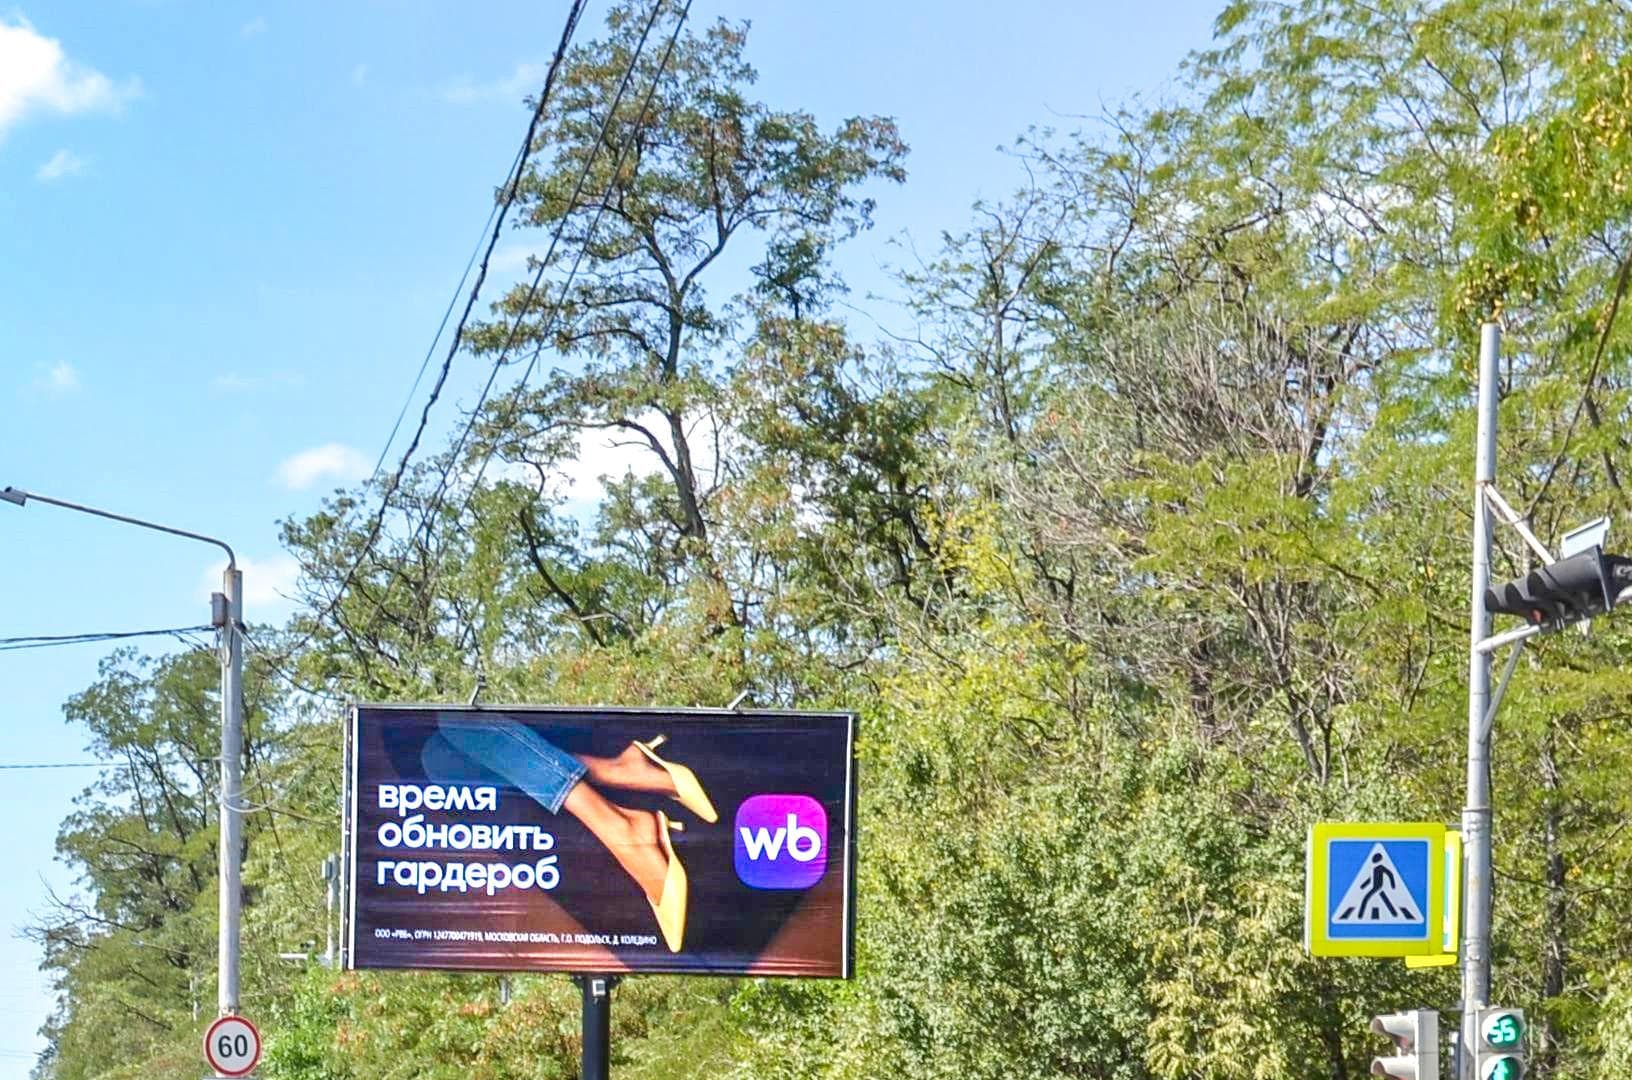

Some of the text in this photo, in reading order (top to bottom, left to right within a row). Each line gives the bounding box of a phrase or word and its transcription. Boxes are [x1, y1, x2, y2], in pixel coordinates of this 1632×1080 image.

[378, 784, 496, 817] время
[377, 814, 554, 850] обновить
[739, 813, 822, 862] wb
[377, 855, 560, 895] гардероб
[374, 929, 390, 939] ООО
[218, 1034, 248, 1058] 60
